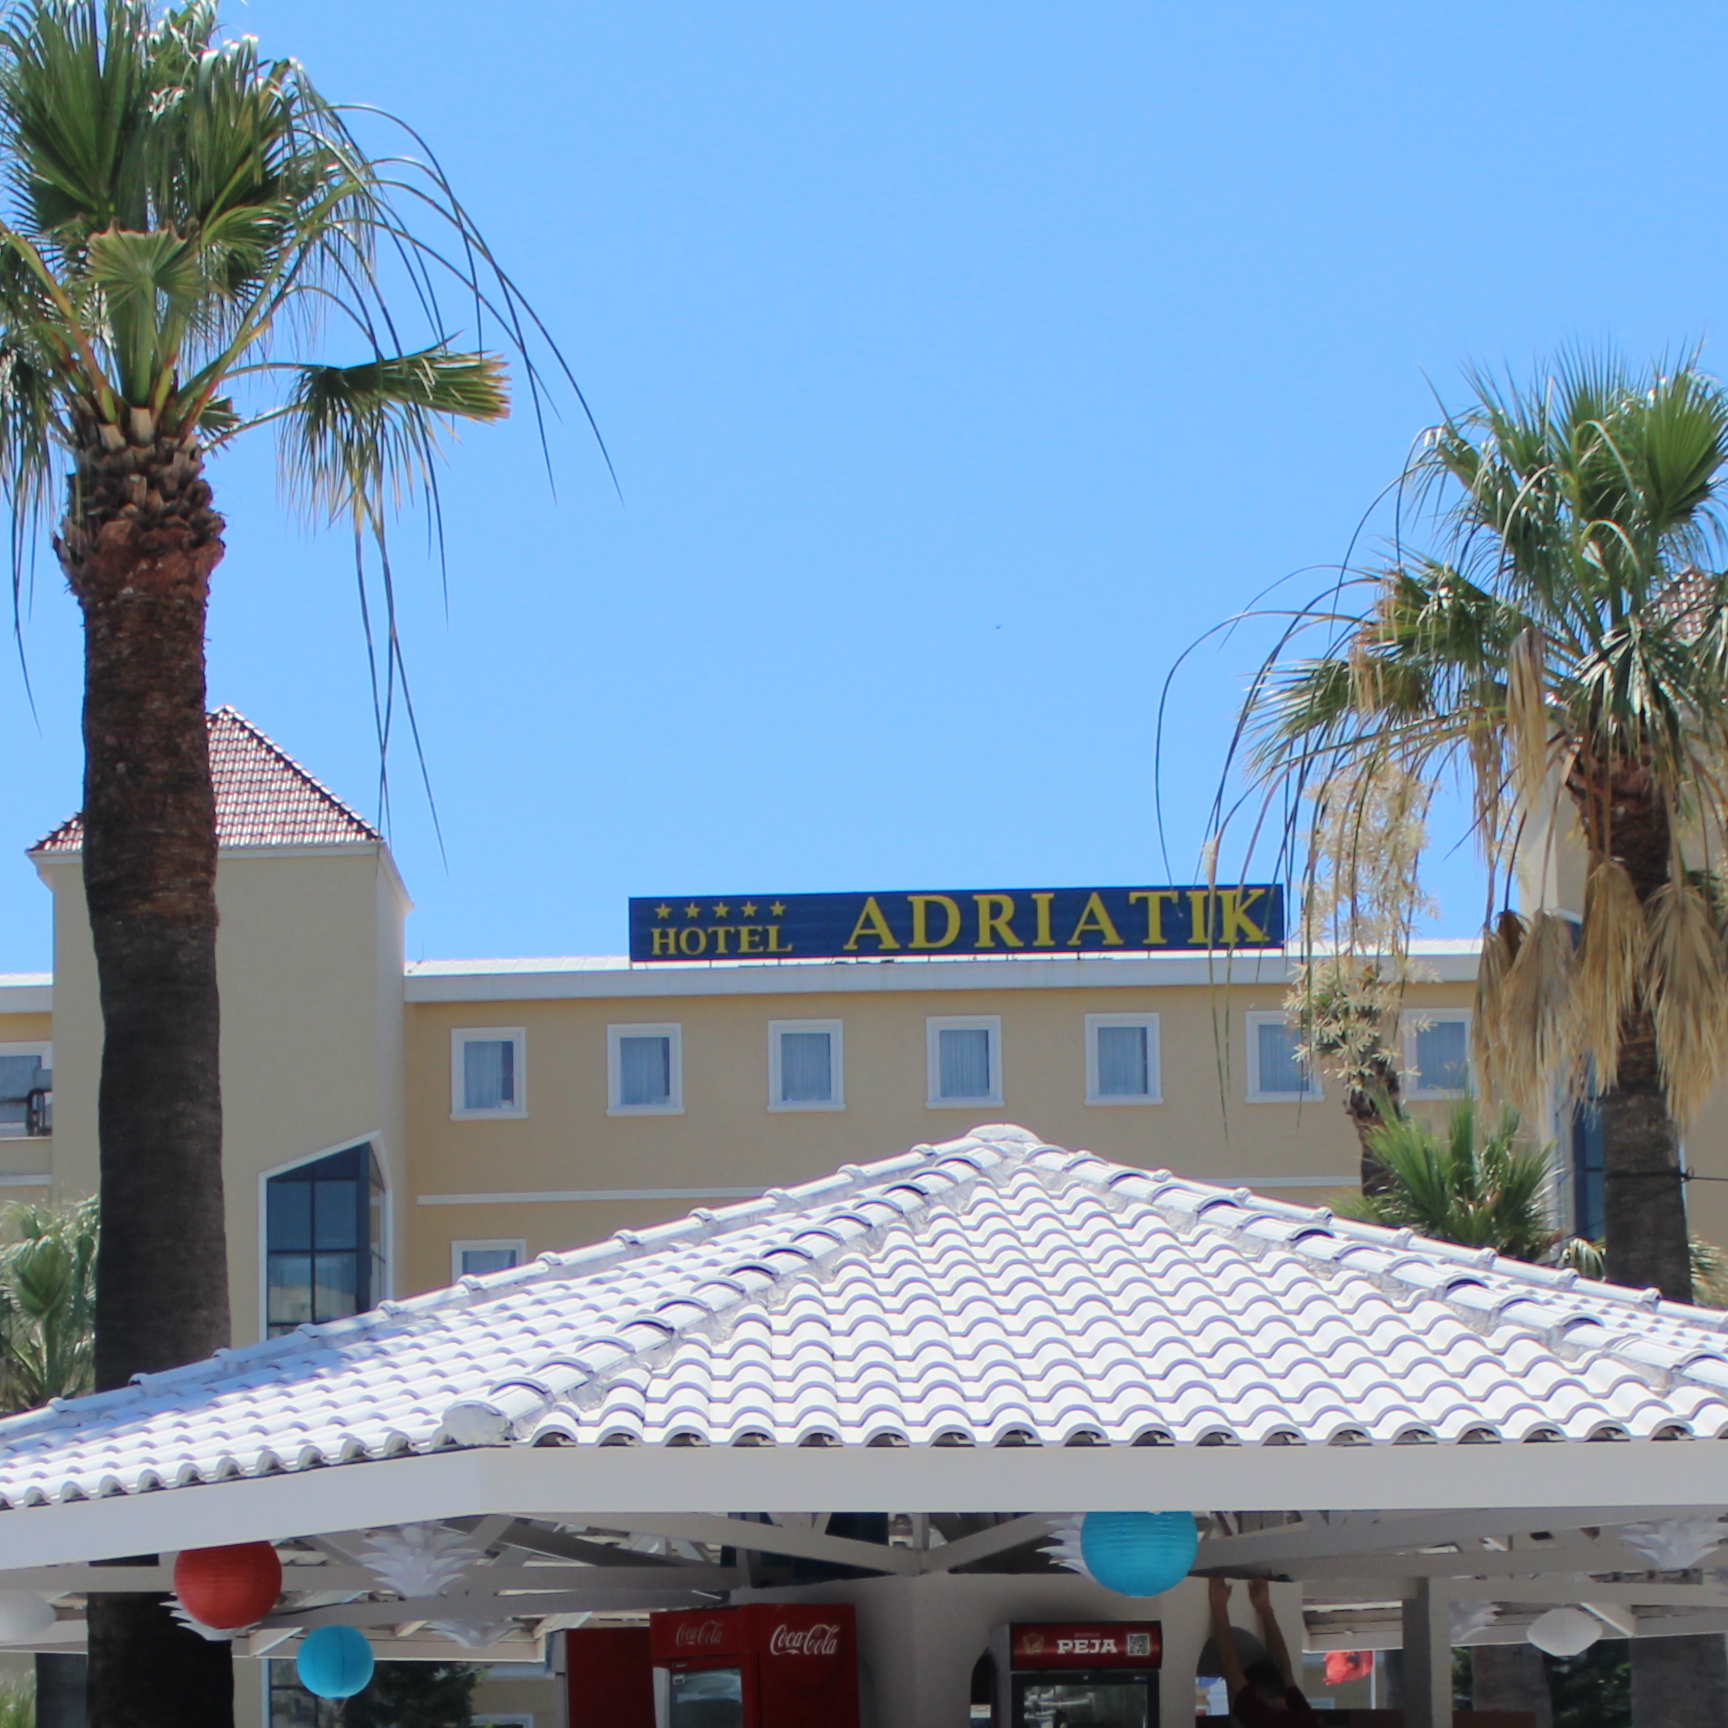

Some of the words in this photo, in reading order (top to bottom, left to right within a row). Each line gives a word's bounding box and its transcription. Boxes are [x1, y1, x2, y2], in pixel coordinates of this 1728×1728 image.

[844, 889, 1271, 950] ADRIATIK
[650, 924, 793, 956] HOTEL
[770, 1624, 840, 1656] Coca-Cola
[1057, 1639, 1118, 1654] PEJA
